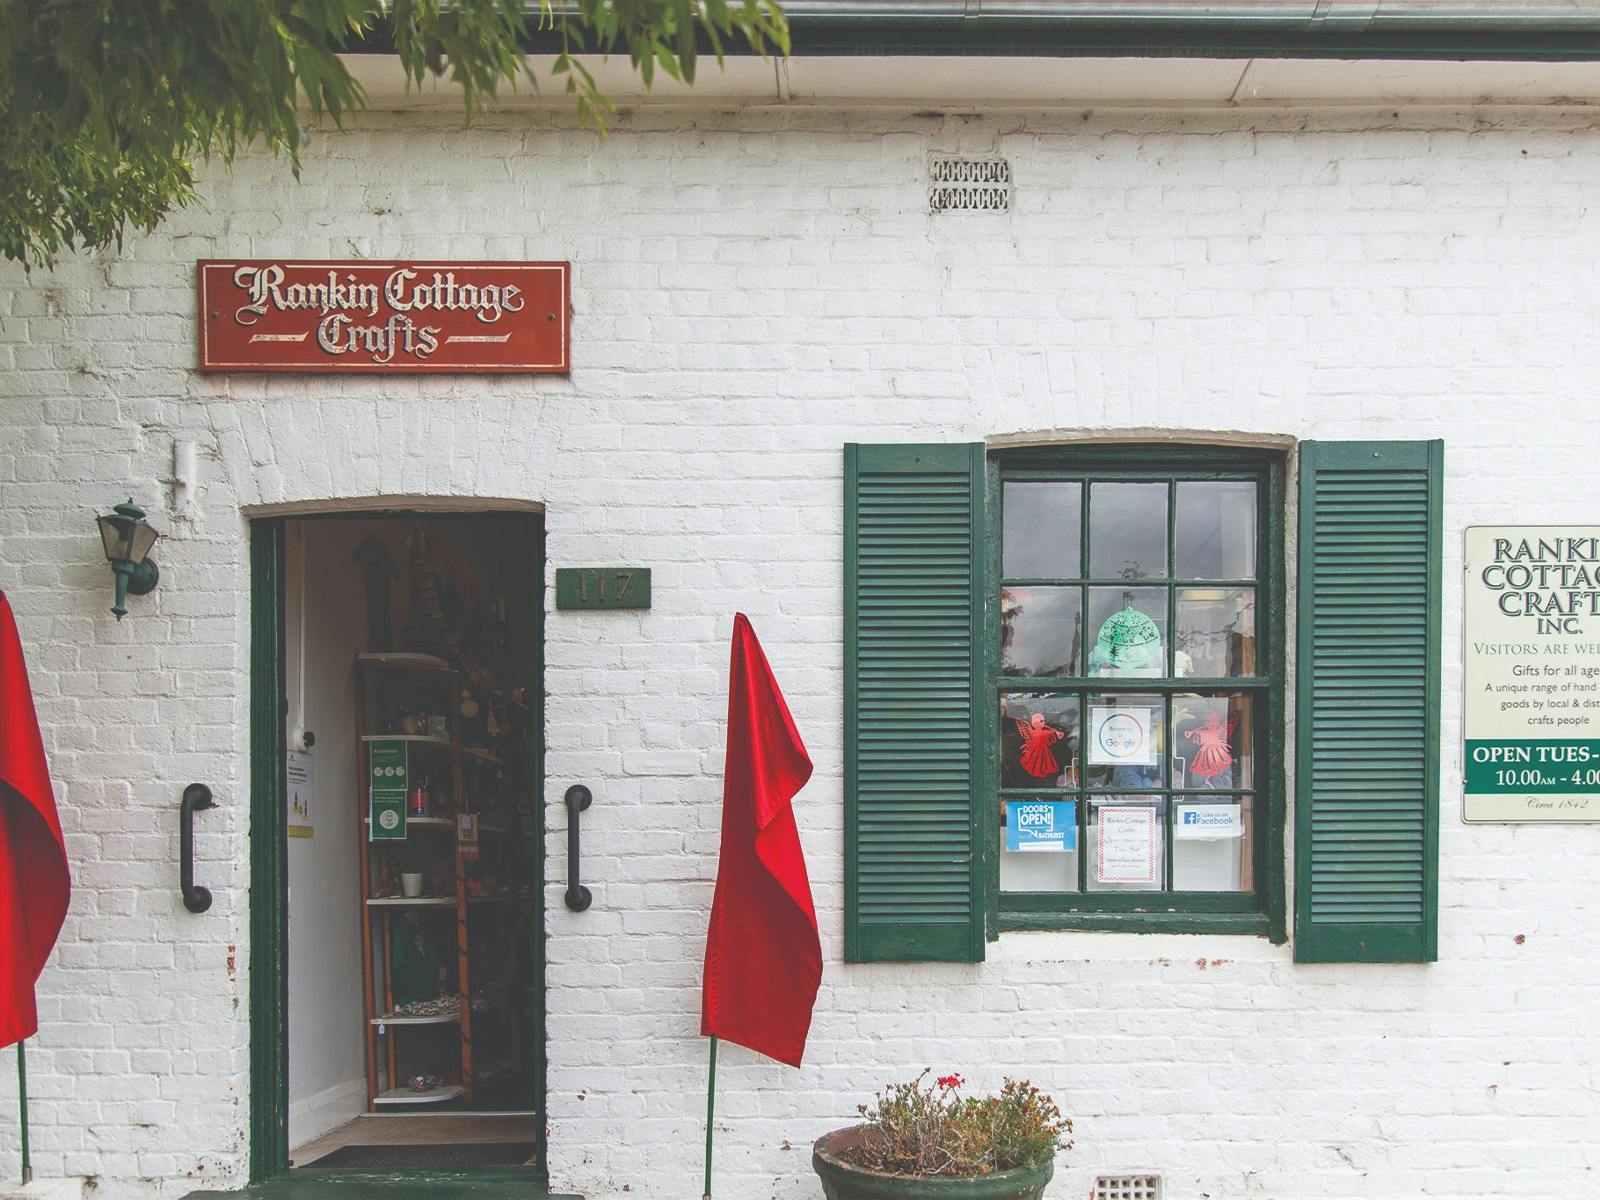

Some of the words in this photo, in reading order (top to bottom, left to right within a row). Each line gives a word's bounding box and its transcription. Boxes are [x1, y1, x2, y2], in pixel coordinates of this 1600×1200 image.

[234, 264, 379, 325] Rankin
[385, 267, 525, 323] Cottage
[317, 312, 443, 363] Crafts
[1494, 537, 1600, 563] RANKI
[1481, 564, 1600, 590] COTTA
[578, 572, 632, 601] 117
[1498, 591, 1600, 617] CRAFT
[1537, 617, 1583, 635] INC.
[1512, 664, 1540, 677] Gifts
[1544, 664, 1561, 677] for
[1564, 664, 1577, 676] all
[1580, 667, 1600, 679] age
[1485, 683, 1493, 693] A
[1496, 683, 1528, 695] unique
[1531, 685, 1558, 695] range
[1561, 682, 1571, 693] of
[1573, 682, 1597, 692] hand
[1501, 699, 1530, 711] goods
[1533, 699, 1544, 710] by
[1547, 699, 1570, 709] local
[1572, 699, 1580, 709] &
[1527, 715, 1554, 725] crafts
[1557, 716, 1590, 728] people
[1472, 746, 1532, 763] OPEN
[1022, 805, 1049, 814] DOORS
[1525, 795, 1554, 809] Circa
[1020, 812, 1051, 826] OPEN!
